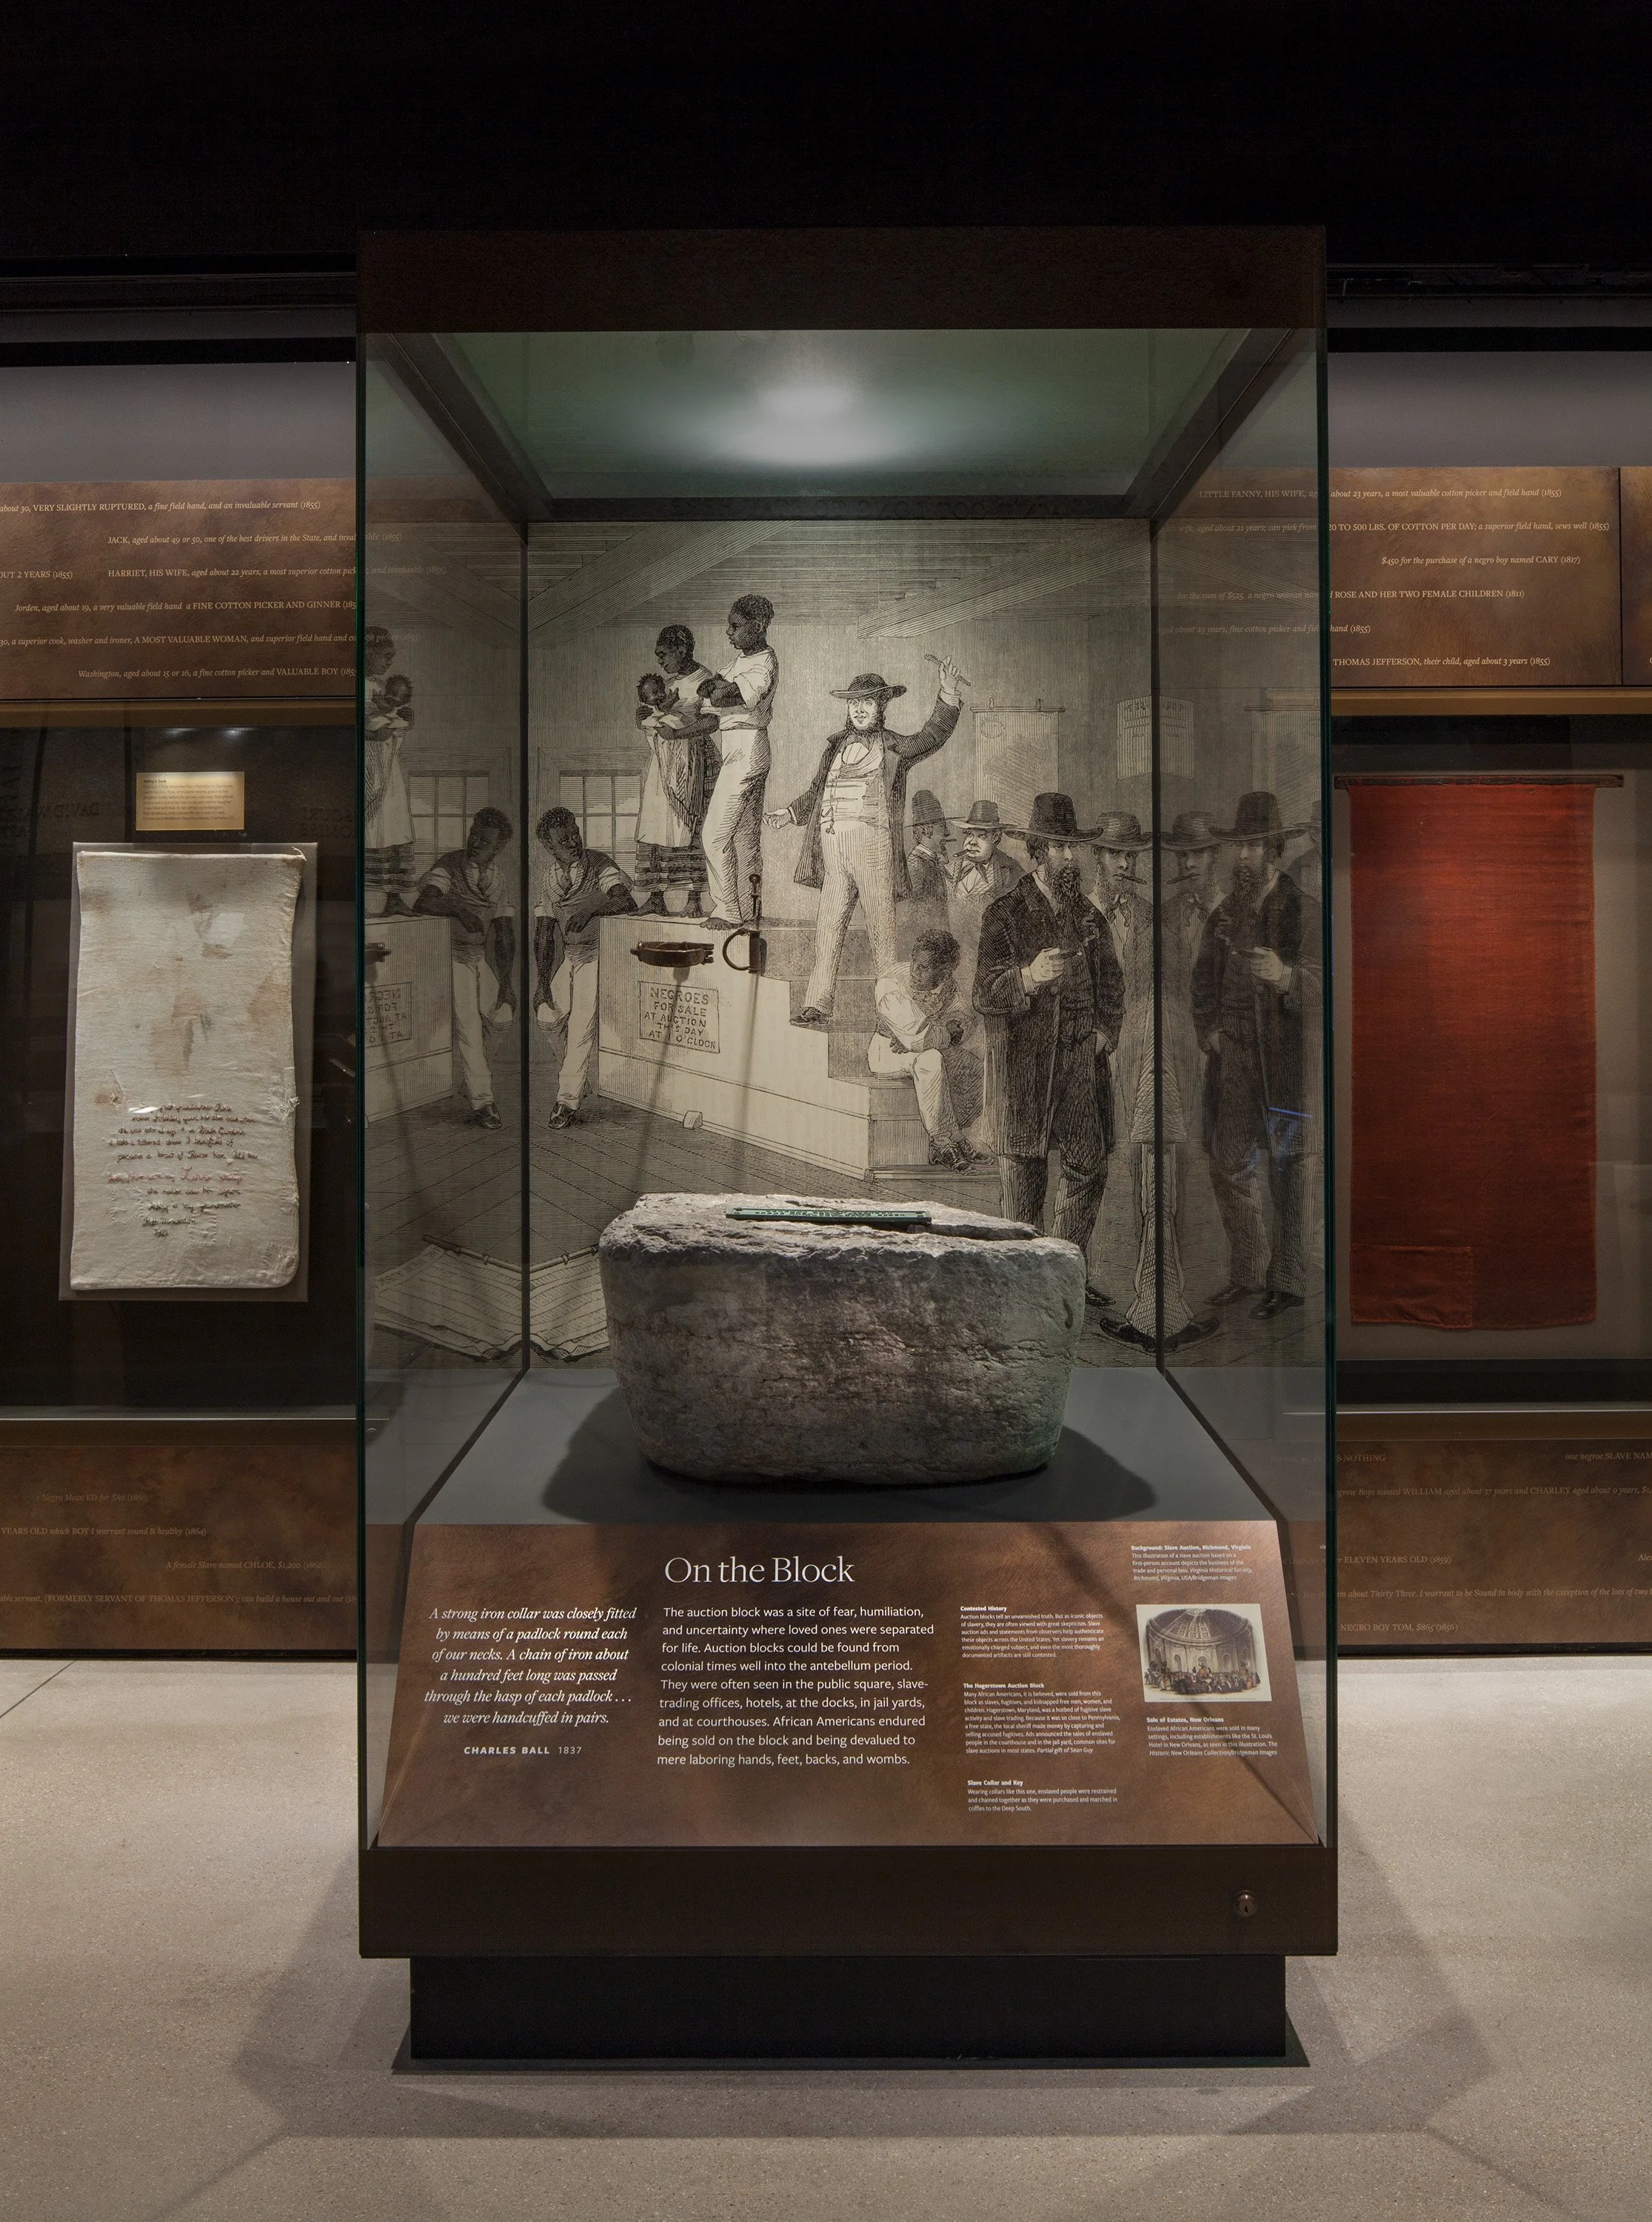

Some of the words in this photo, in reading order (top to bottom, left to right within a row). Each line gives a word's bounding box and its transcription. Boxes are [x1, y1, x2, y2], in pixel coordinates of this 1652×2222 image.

[19, 505, 31, 513] 30,
[56, 503, 97, 511] SLIGHTLY
[98, 502, 146, 511] RUPTURED,
[153, 501, 168, 512] fine
[167, 501, 185, 511] field
[186, 501, 207, 510] hand,
[207, 501, 222, 509] and
[234, 500, 270, 509] invaluable
[300, 500, 321, 510] (1855)
[1380, 556, 1399, 566] $450
[1398, 556, 1412, 566] for
[1412, 556, 1424, 564] the
[1424, 556, 1457, 566] purchase
[1458, 556, 1468, 566] of
[1474, 557, 1494, 565] negro
[1495, 555, 1508, 565] boy
[1509, 555, 1534, 563] named
[1559, 555, 1580, 565] (1817)
[1332, 658, 1370, 666] THOMAS
[1371, 657, 1422, 666] JEFFERSON,
[1423, 657, 1441, 665] their
[1442, 656, 1462, 666] child,
[1462, 656, 1480, 667] aged
[1480, 656, 1502, 664] about
[1502, 658, 1508, 666] 3
[1507, 658, 1528, 667] years
[1529, 656, 1551, 666] (1855)
[651, 987, 709, 1005] NEGROES
[654, 1002, 674, 1012] FOR
[678, 1005, 706, 1017] SALE
[644, 1012, 656, 1020] AT
[661, 1014, 706, 1027] AUCTION
[684, 1027, 704, 1035] DAY
[649, 1030, 662, 1038] AT
[676, 1035, 716, 1049] O'CLOCK
[664, 1557, 712, 1583] On
[718, 1555, 765, 1583] the
[771, 1555, 855, 1582] Block
[428, 1607, 438, 1618] A
[441, 1609, 478, 1622] strong
[480, 1607, 504, 1619] iron
[506, 1607, 541, 1619] collar
[542, 1610, 564, 1619] was
[566, 1607, 603, 1622] closely
[602, 1607, 637, 1621] fitted
[663, 1607, 683, 1617] The
[686, 1607, 727, 1617] auction
[731, 1607, 760, 1617] block
[763, 1609, 783, 1617] was
[786, 1609, 793, 1617] a
[795, 1607, 815, 1617] site
[818, 1606, 830, 1616] of
[832, 1606, 857, 1618] fear,
[860, 1606, 923, 1618] humiliation,
[435, 1627, 449, 1642] by
[452, 1630, 490, 1639] means
[492, 1627, 506, 1642] of
[505, 1630, 514, 1639] a
[514, 1627, 561, 1643] padlock
[563, 1627, 600, 1639] round
[601, 1627, 627, 1639] each
[662, 1624, 683, 1635] and
[686, 1624, 749, 1638] uncertainty
[751, 1624, 785, 1635] where
[788, 1624, 817, 1635] loved
[820, 1626, 847, 1634] ones
[849, 1626, 877, 1634] were
[880, 1624, 934, 1637] separated
[1340, 1624, 1371, 1632] NEGRO
[1372, 1623, 1390, 1632] BOY
[1415, 1623, 1434, 1632] $865
[1435, 1623, 1458, 1632] (1856)
[661, 1642, 678, 1652] for
[681, 1641, 700, 1652] life.
[703, 1642, 746, 1652] Auction
[749, 1642, 784, 1652] blocks
[786, 1641, 817, 1652] could
[820, 1641, 834, 1652] be
[837, 1641, 869, 1652] found
[872, 1641, 899, 1652] from
[431, 1647, 446, 1663] of
[445, 1651, 467, 1660] our
[469, 1647, 502, 1660] necks.
[505, 1648, 515, 1660] A
[518, 1647, 552, 1660] chain
[554, 1647, 569, 1663] of
[567, 1648, 592, 1660] iron
[595, 1647, 629, 1660] about
[661, 1660, 703, 1671] colonial
[706, 1661, 736, 1671] times
[739, 1660, 760, 1671] well
[763, 1661, 786, 1671] into
[788, 1660, 806, 1671] the
[809, 1660, 871, 1671] antebellum
[874, 1660, 912, 1673] period.
[439, 1672, 448, 1681] a
[449, 1668, 502, 1681] hundred
[499, 1668, 524, 1684] feet
[525, 1668, 552, 1684] long
[553, 1672, 576, 1681] was
[576, 1668, 618, 1684] passed
[424, 1689, 471, 1705] through
[472, 1689, 492, 1702] the
[493, 1689, 522, 1706] hasp
[524, 1689, 539, 1705] of
[538, 1689, 565, 1702] each
[565, 1689, 612, 1706] padlock
[443, 1714, 460, 1724] we
[461, 1714, 490, 1723] were
[492, 1710, 559, 1726] handcuffed
[560, 1711, 573, 1723] in
[574, 1711, 609, 1727] pairs.
[464, 1746, 516, 1754] CHARLES
[521, 1746, 549, 1754] BALL
[558, 1746, 581, 1754] 1837
